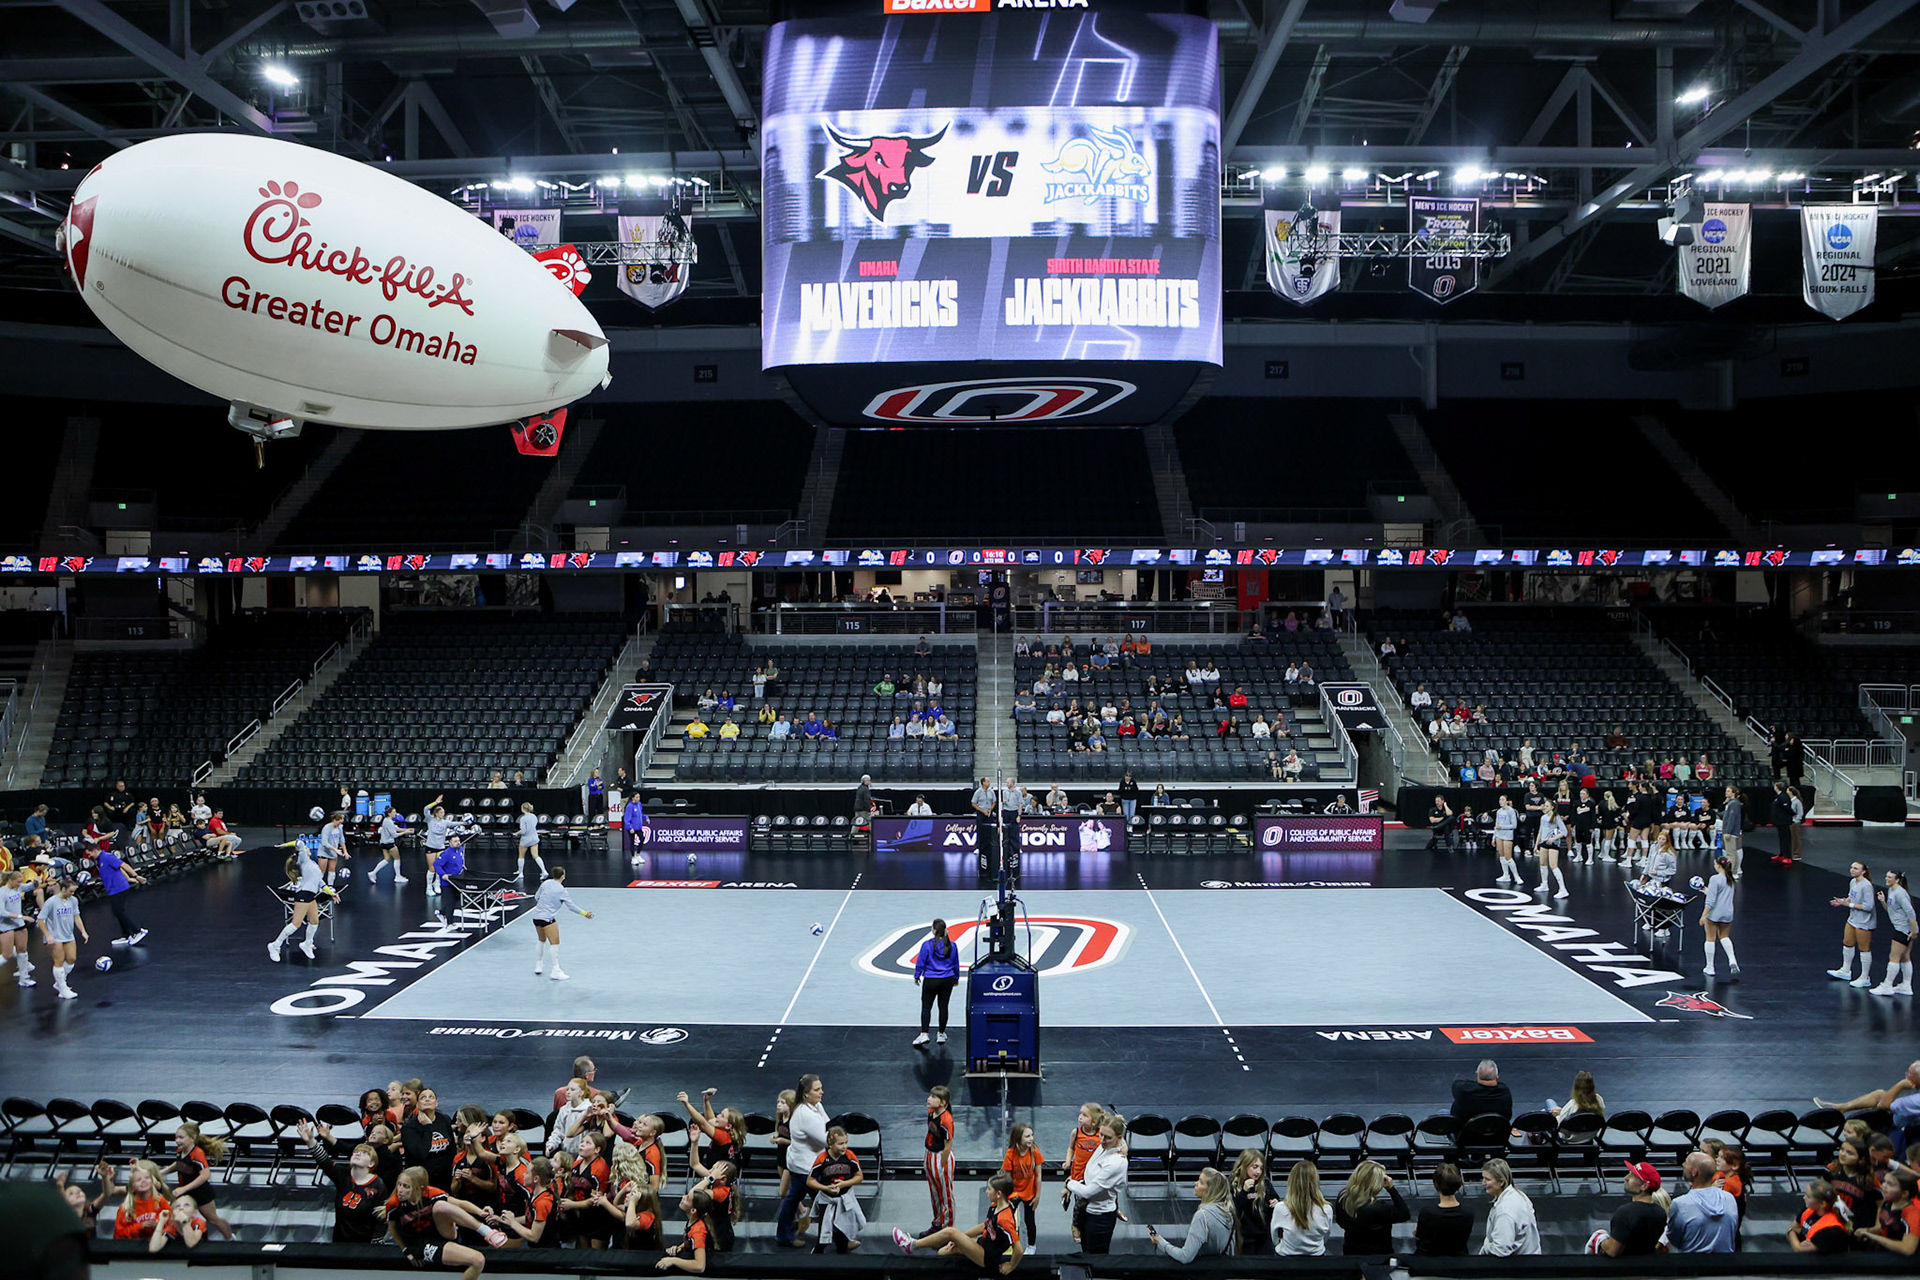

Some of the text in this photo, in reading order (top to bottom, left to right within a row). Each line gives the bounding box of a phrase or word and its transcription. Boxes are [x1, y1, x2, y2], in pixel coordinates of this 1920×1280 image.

[967, 151, 1018, 197] VS
[1415, 201, 1474, 212] MEN'S ICE HOCKEY
[1707, 208, 1744, 216] ICE HOCKEY
[531, 214, 555, 222] HOCKEY
[1424, 216, 1470, 229] FROZEN
[1691, 245, 1738, 253] REGIONAL
[1816, 251, 1862, 260] REGIONAL
[859, 260, 898, 277] OMAHA
[1046, 258, 1160, 275] SOUTH DAKOTA STATE
[1697, 257, 1731, 274] 2021
[1822, 264, 1857, 281] 2024
[1691, 278, 1737, 286] LOVELAND
[1810, 285, 1868, 294] SIOUX FALLS
[800, 279, 958, 330] MAVERICKS
[1005, 278, 1199, 328] JACKRABBITS
[222, 276, 478, 365] Greater Omaha
[926, 551, 936, 564] 0
[973, 551, 981, 562] 0
[1007, 551, 1016, 562] 0
[1054, 551, 1064, 564] 0
[844, 621, 860, 630] 115
[1130, 619, 1147, 629] 117
[1872, 620, 1891, 629] 119
[127, 626, 144, 636] 113
[657, 829, 744, 837] COLLEGE OF PUBLIC AFFAIRS
[943, 832, 1065, 846] AVION
[1464, 888, 1685, 988] OMAHA
[270, 904, 520, 1016] OMAHA
[1315, 1029, 1576, 1041] Baxter ARENA
